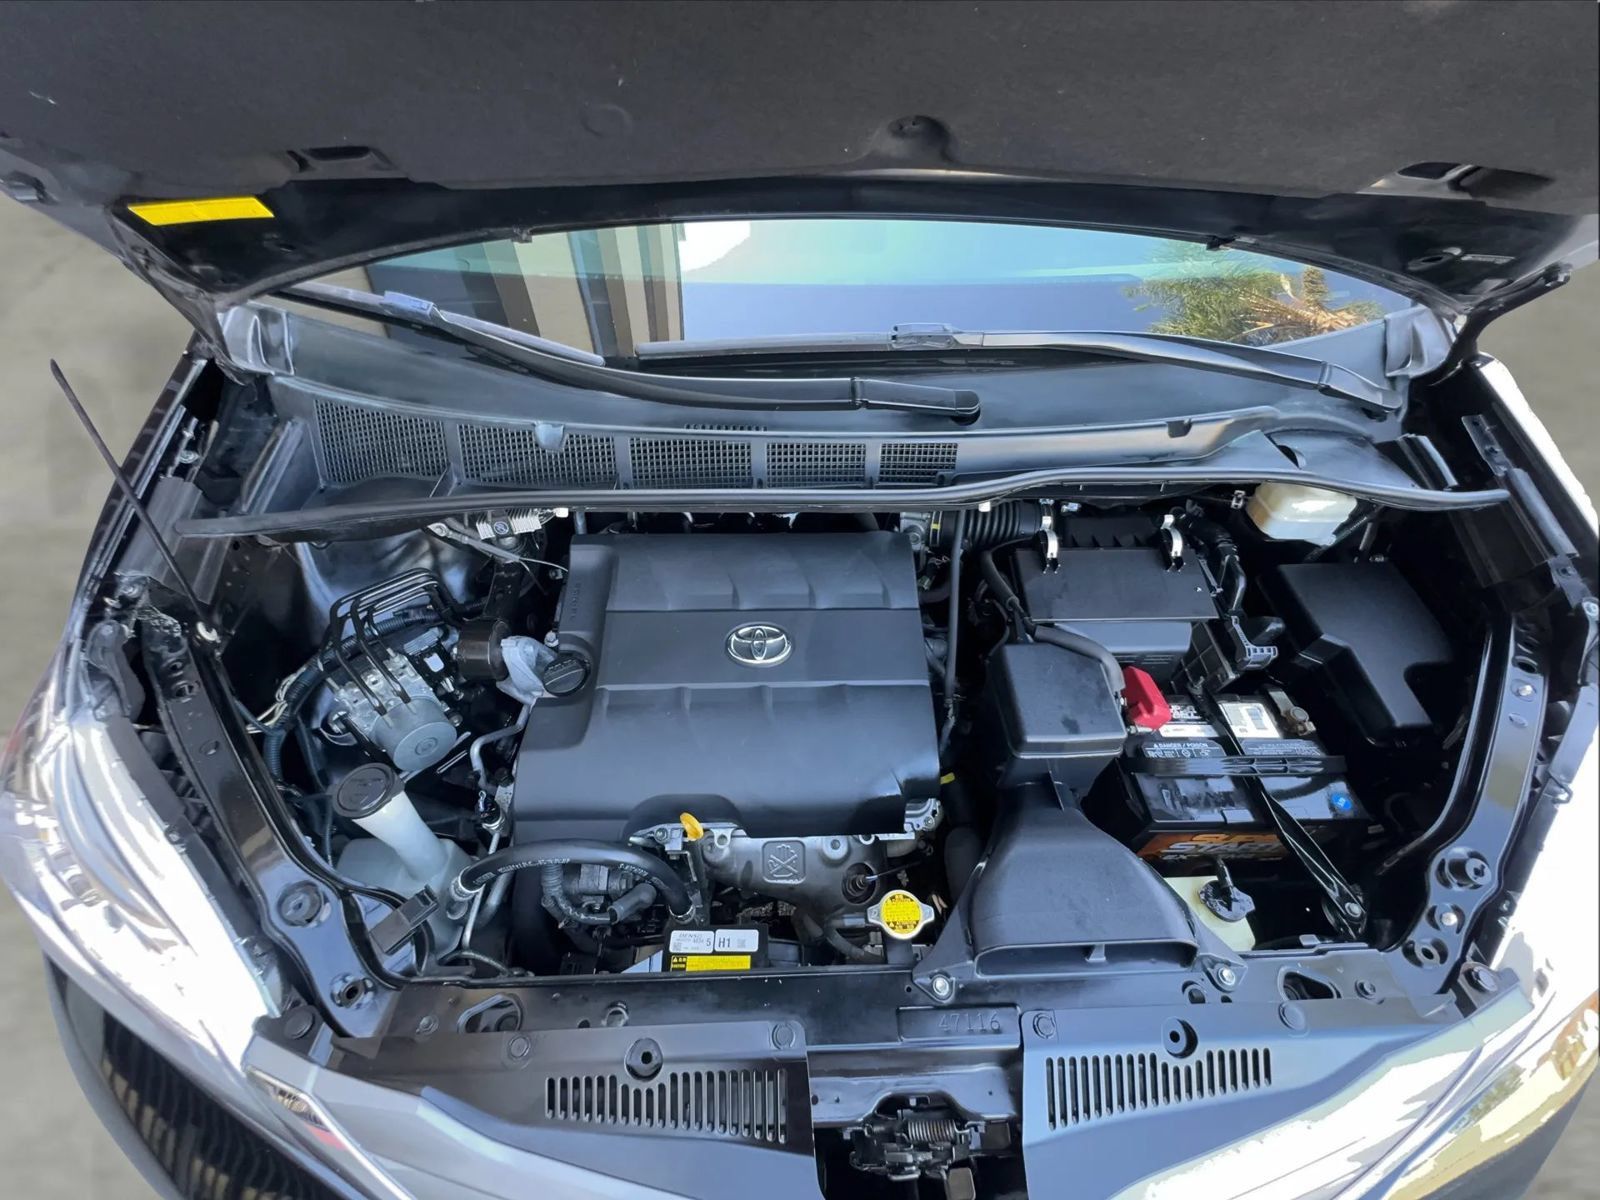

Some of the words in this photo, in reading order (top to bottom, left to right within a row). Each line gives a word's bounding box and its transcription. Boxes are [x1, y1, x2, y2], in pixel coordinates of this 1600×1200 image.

[706, 938, 711, 947] 5
[718, 937, 731, 948] H1
[938, 1011, 1001, 1032] 47116
